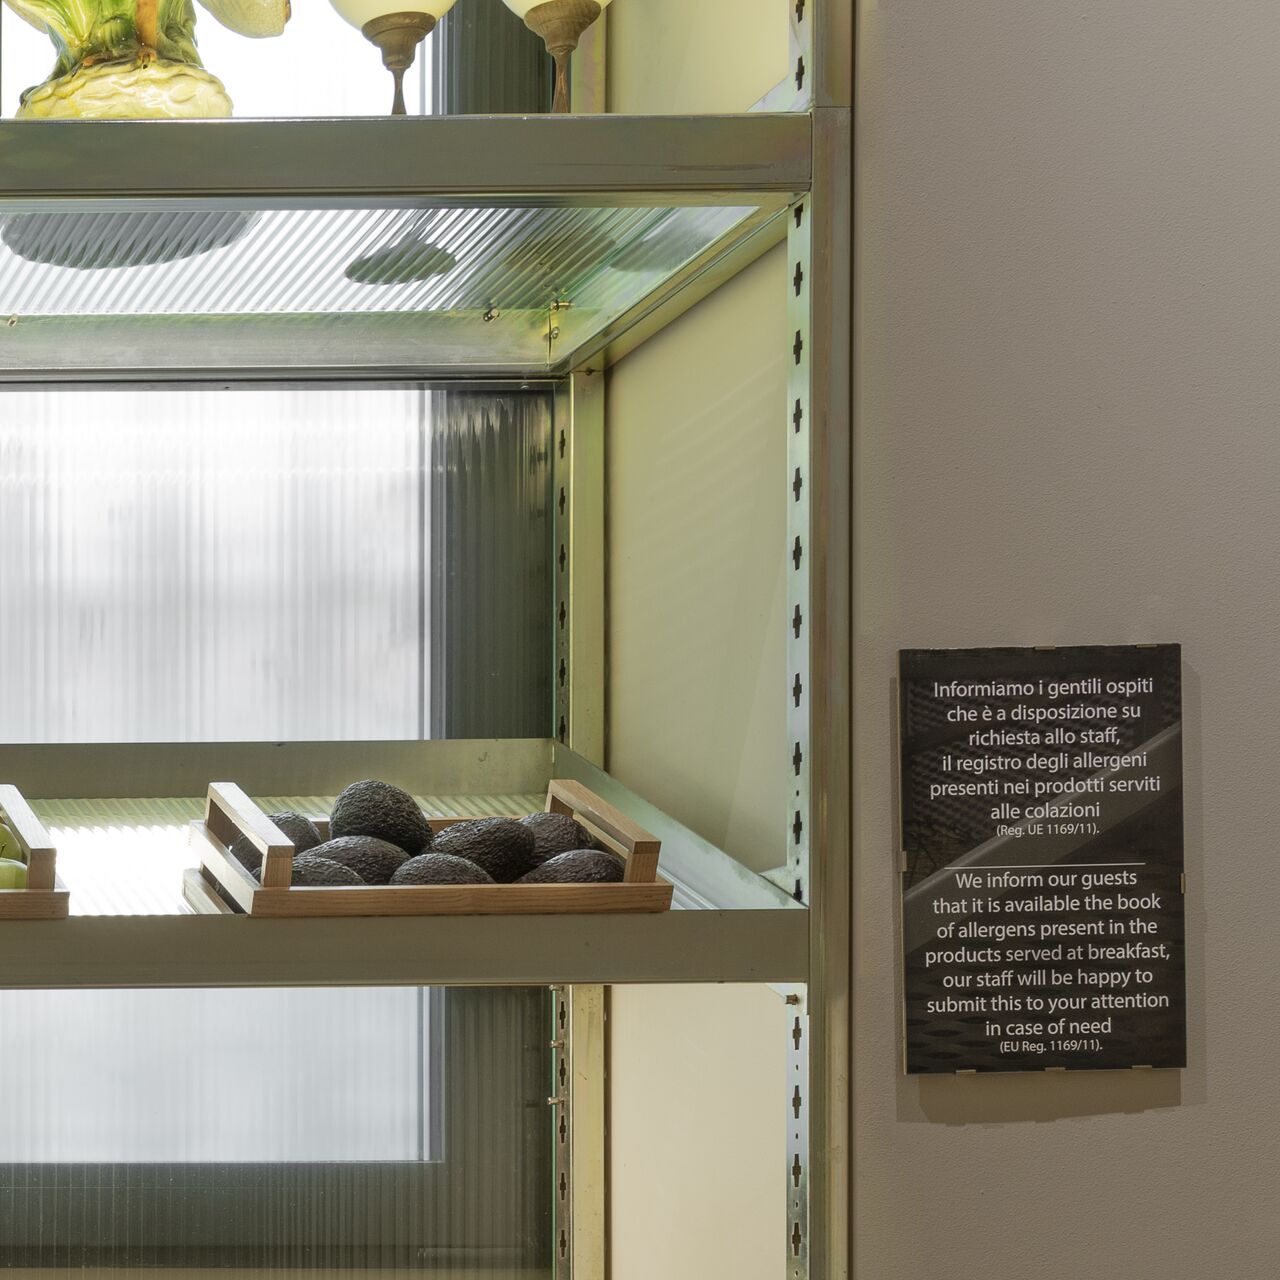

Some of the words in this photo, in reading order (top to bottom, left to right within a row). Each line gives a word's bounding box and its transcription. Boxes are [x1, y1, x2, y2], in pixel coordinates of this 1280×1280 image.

[934, 681, 1034, 698] Informiamo
[1039, 680, 1043, 695] i
[1048, 678, 1101, 699] gentili
[1106, 677, 1153, 697] ospiti
[947, 705, 978, 722] che
[982, 705, 992, 721] è
[996, 709, 1006, 721] a
[1011, 703, 1117, 724] disposizione
[1122, 706, 1141, 718] su
[969, 729, 1040, 746] richiesta
[1044, 728, 1076, 744] allo
[1080, 726, 1120, 745] staff,
[942, 755, 951, 771] il
[957, 755, 1022, 775] registro
[1026, 752, 1068, 773] degli
[1073, 751, 1147, 772] allergeni
[930, 779, 998, 800] presenti
[1004, 779, 1029, 794] nei
[1035, 777, 1104, 798] prodotti
[1109, 776, 1160, 792] serviti
[990, 803, 1021, 819] alle
[1025, 802, 1100, 819] colazioni
[996, 824, 1025, 838] (Reg.
[1028, 824, 1043, 835] UE
[1047, 822, 1100, 835] 1169/11).
[955, 873, 982, 888] We
[987, 871, 1043, 888] inform
[1048, 874, 1078, 887] our
[1081, 870, 1137, 890] guests
[932, 897, 968, 914] that
[972, 898, 984, 913] it
[988, 897, 1000, 913] is
[1005, 895, 1080, 912] available
[1084, 894, 1113, 910] the
[1118, 893, 1161, 910] book
[937, 922, 955, 939] of
[958, 921, 1036, 941] allergens
[1040, 920, 1105, 940] present
[1109, 919, 1125, 934] in
[1128, 918, 1158, 934] the
[925, 946, 1001, 967] products
[1006, 944, 1062, 962] served
[1067, 946, 1084, 960] at
[1088, 942, 1170, 960] breakfast,
[943, 975, 972, 988] our
[976, 970, 1014, 987] staff
[1017, 969, 1046, 986] will
[1051, 969, 1073, 985] be
[1078, 968, 1131, 988] happy
[1134, 969, 1153, 983] to
[927, 996, 987, 1013] submit
[990, 995, 1022, 1011] this
[1026, 996, 1044, 1011] to
[1048, 997, 1087, 1014] your
[1091, 992, 1169, 1009] attention
[986, 1021, 1001, 1036] in
[1006, 1023, 1043, 1036] case
[1047, 1018, 1066, 1035] of
[1069, 1017, 1111, 1034] need
[1000, 1041, 1019, 1054] (EU
[1022, 1041, 1047, 1054] Reg.
[1050, 1039, 1103, 1052] 1169/11).
